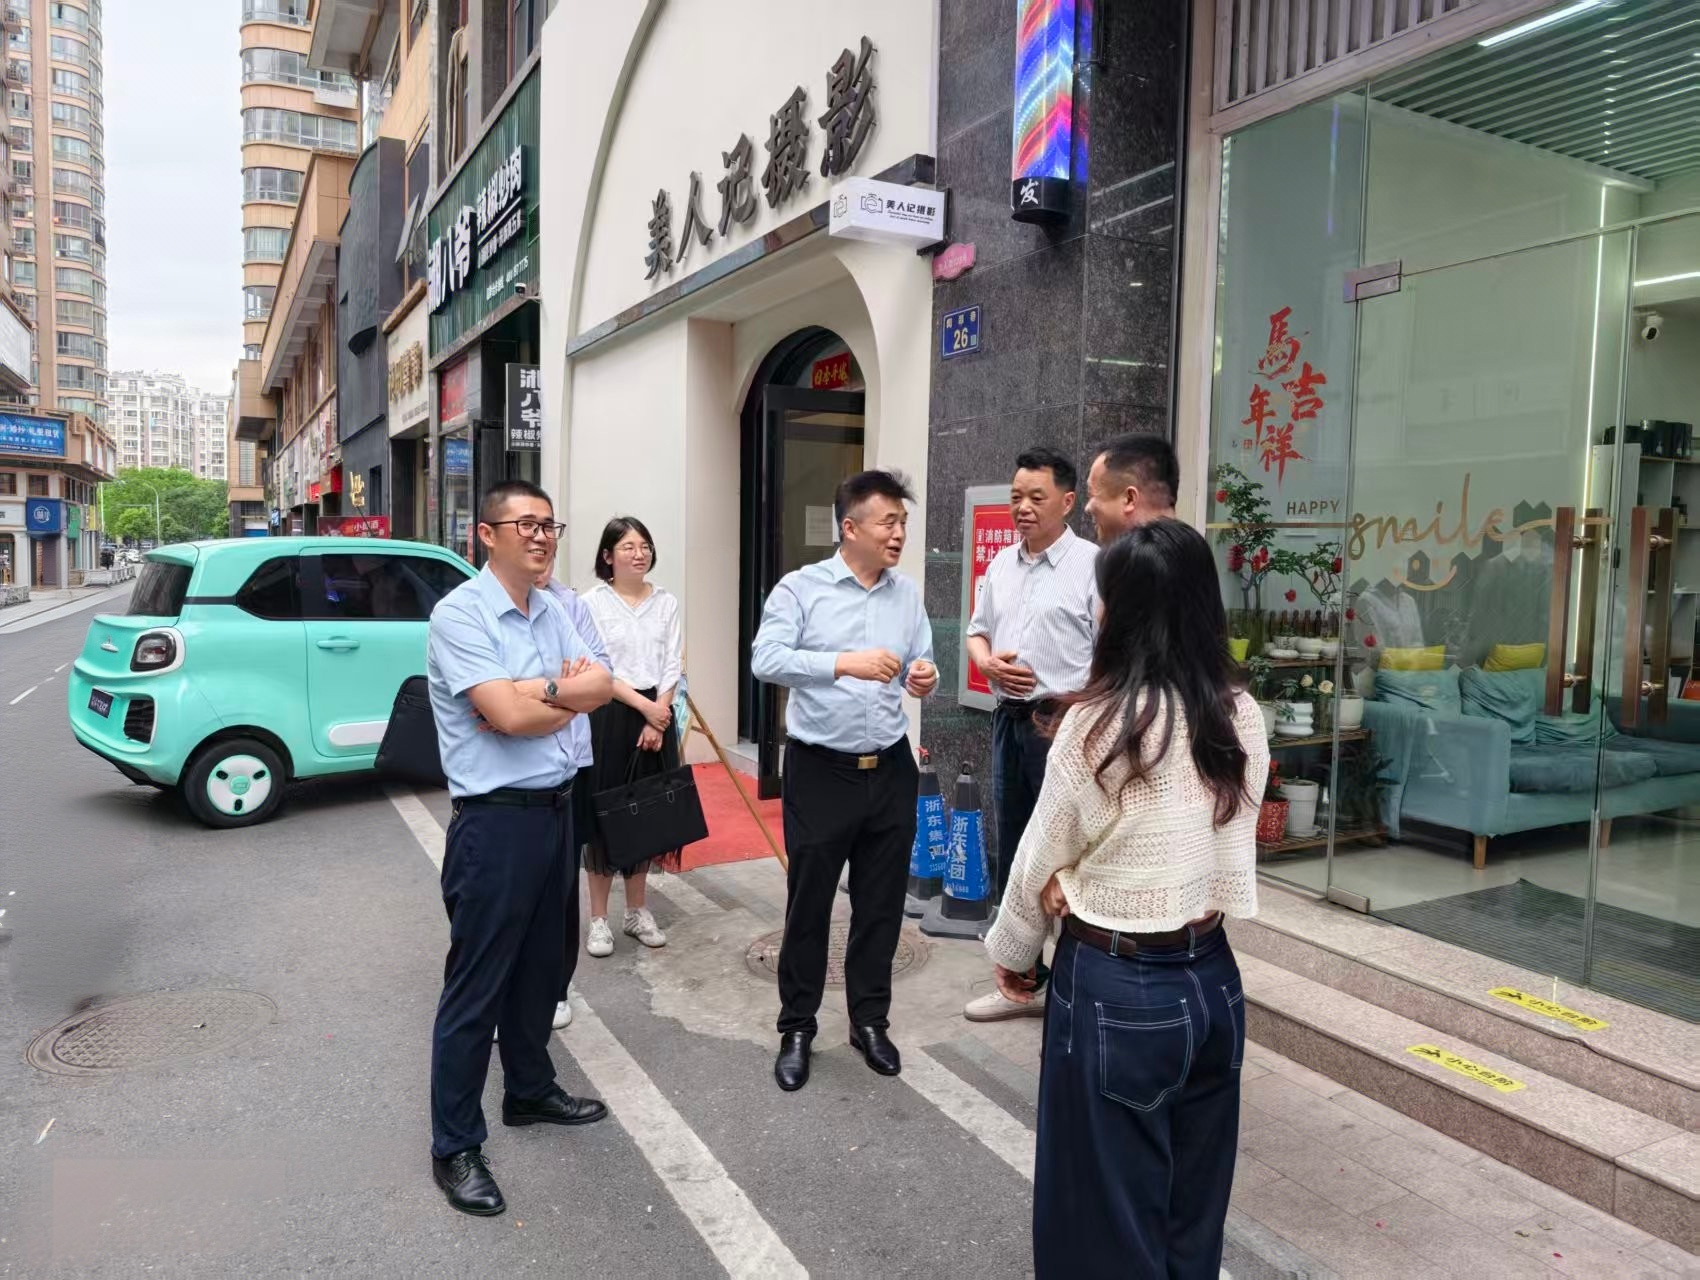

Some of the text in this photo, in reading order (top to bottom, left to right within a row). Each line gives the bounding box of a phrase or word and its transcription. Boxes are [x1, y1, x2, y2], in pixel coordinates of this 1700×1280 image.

[644, 35, 878, 281] 美人记摄影
[1020, 179, 1040, 206] 发
[886, 199, 936, 218] 美人记摄影
[428, 206, 475, 316] 湘八爷
[953, 327, 968, 350] 26
[1286, 500, 1341, 515] HAPPY
[1346, 472, 1510, 561] smile
[975, 545, 1007, 562] 禁止
[925, 800, 946, 860] 浙东集团
